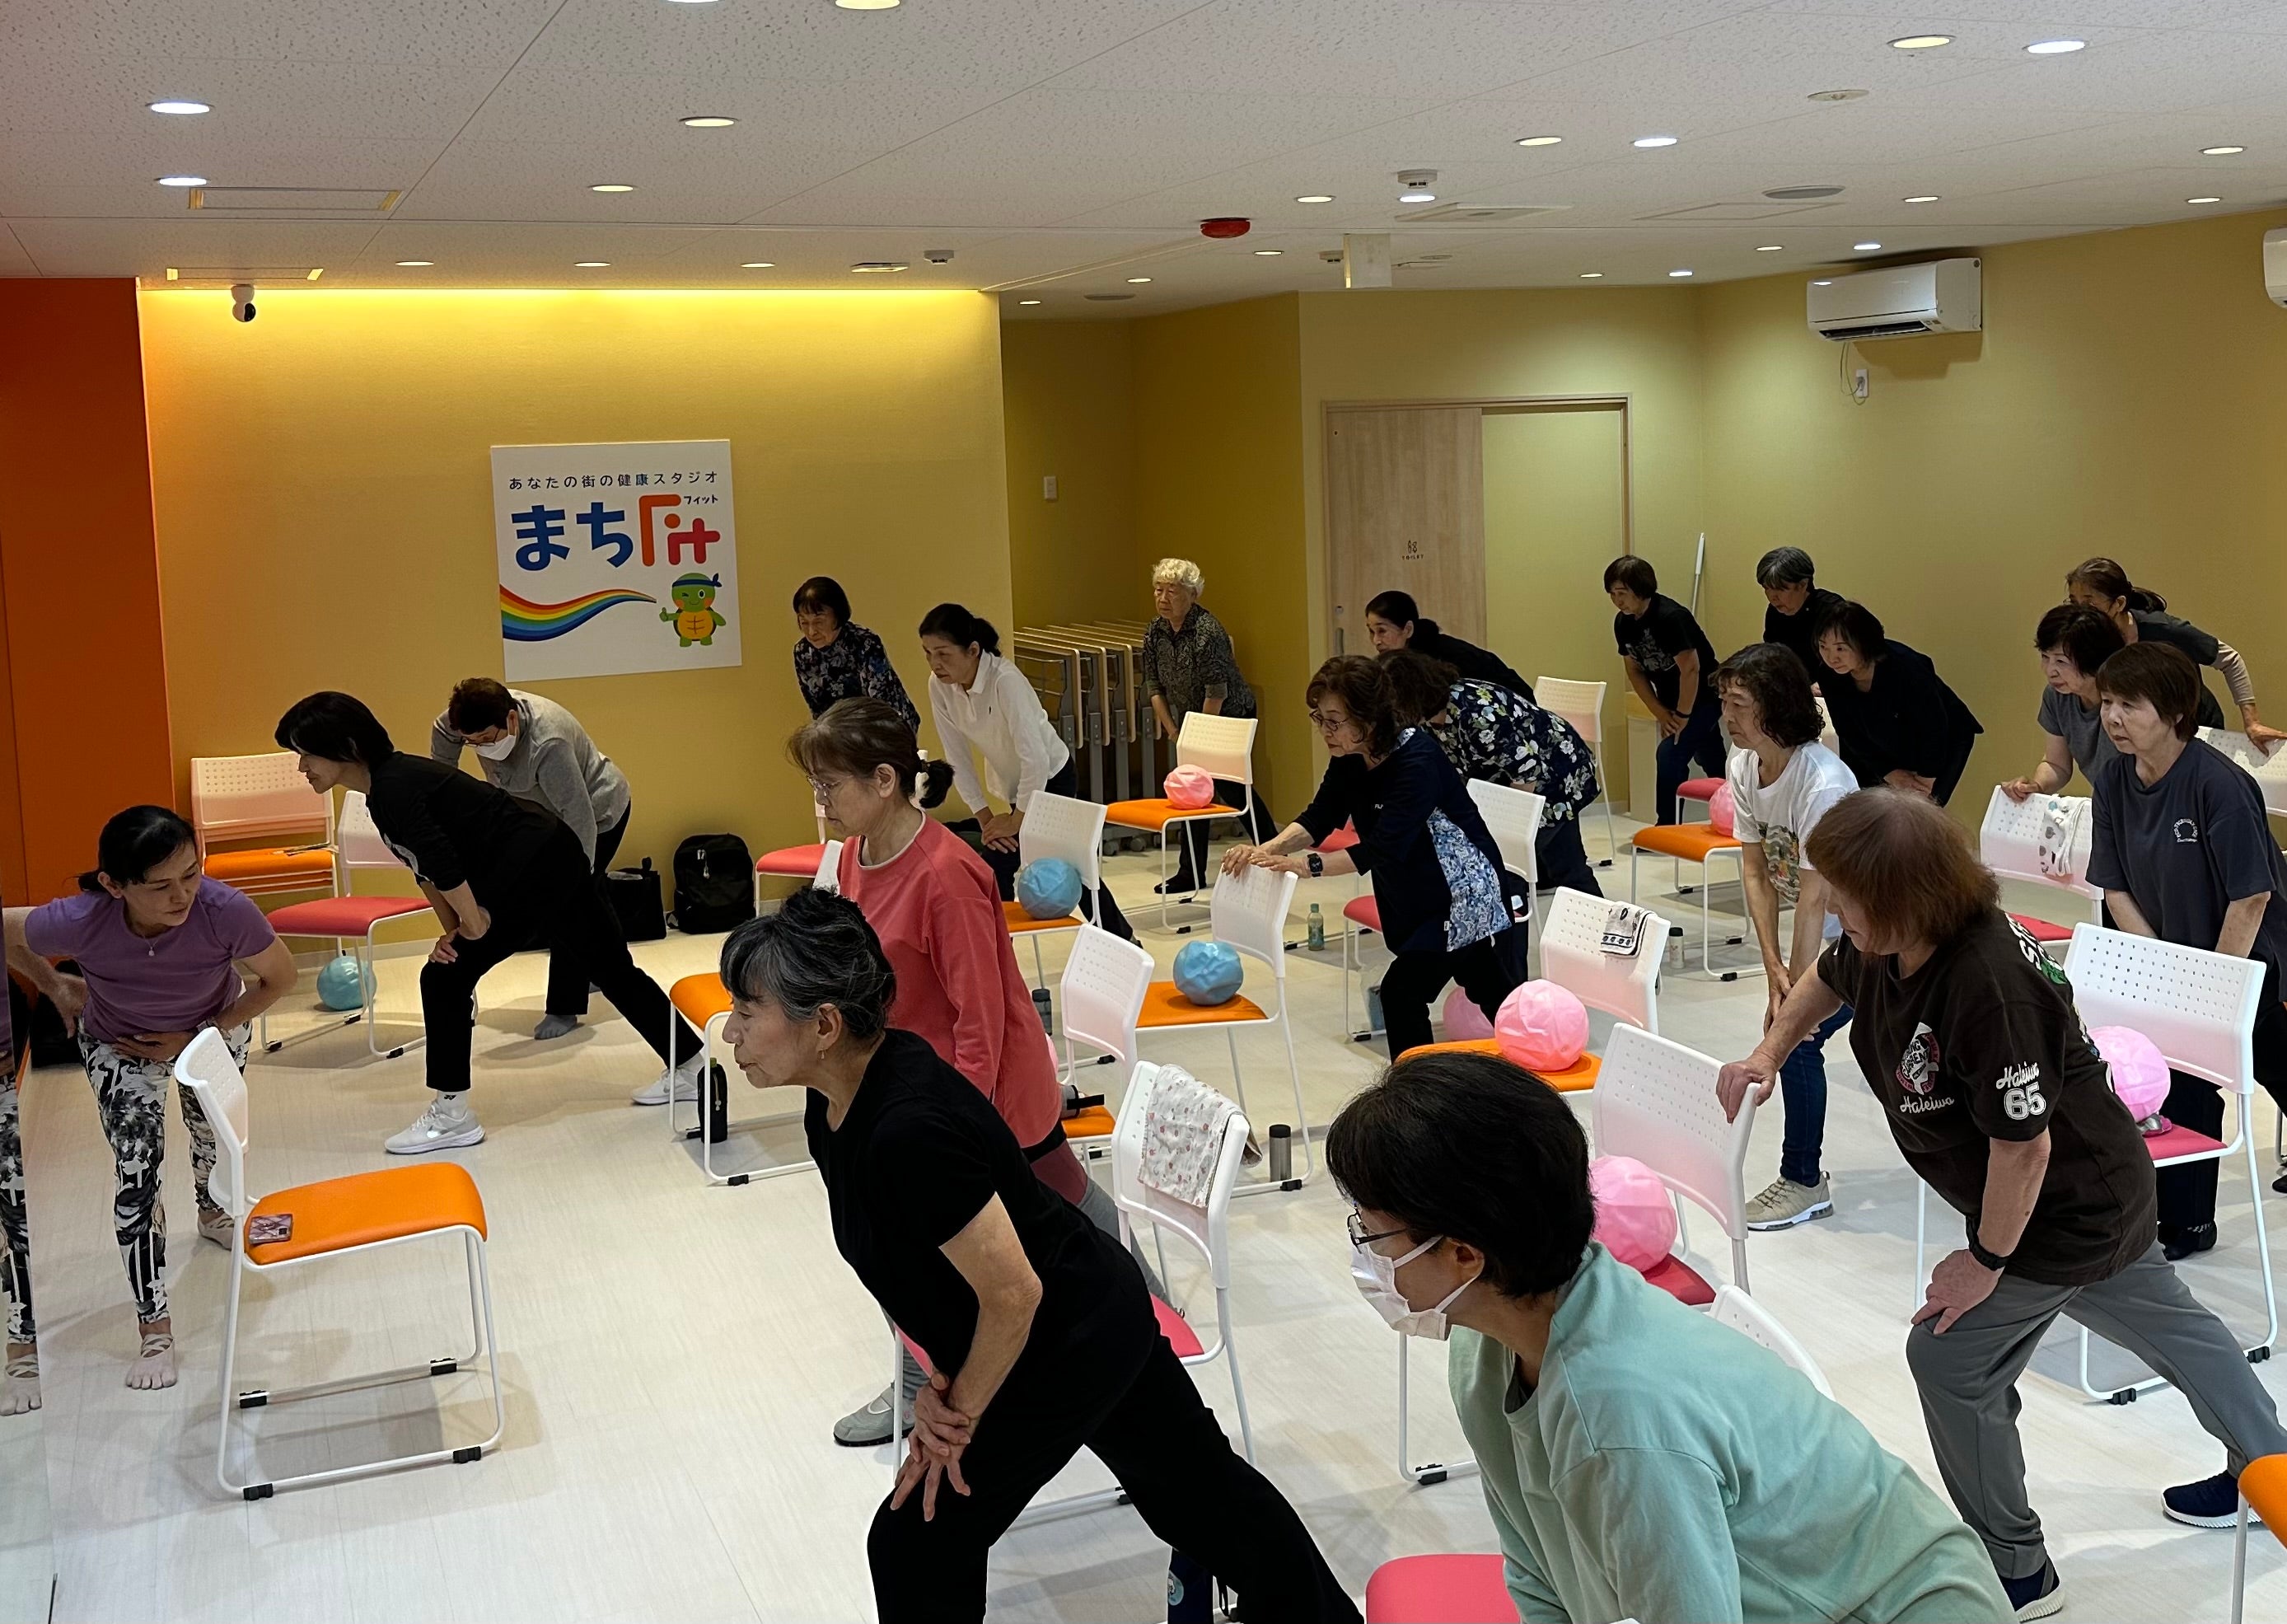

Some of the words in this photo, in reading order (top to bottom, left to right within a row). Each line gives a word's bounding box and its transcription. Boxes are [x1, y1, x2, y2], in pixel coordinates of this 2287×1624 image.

[509, 471, 718, 490] あなたの街の健康スタジオ
[683, 494, 718, 505] フィット
[1900, 1096, 1954, 1114] Haleiwa
[2004, 1081, 2046, 1121] 65
